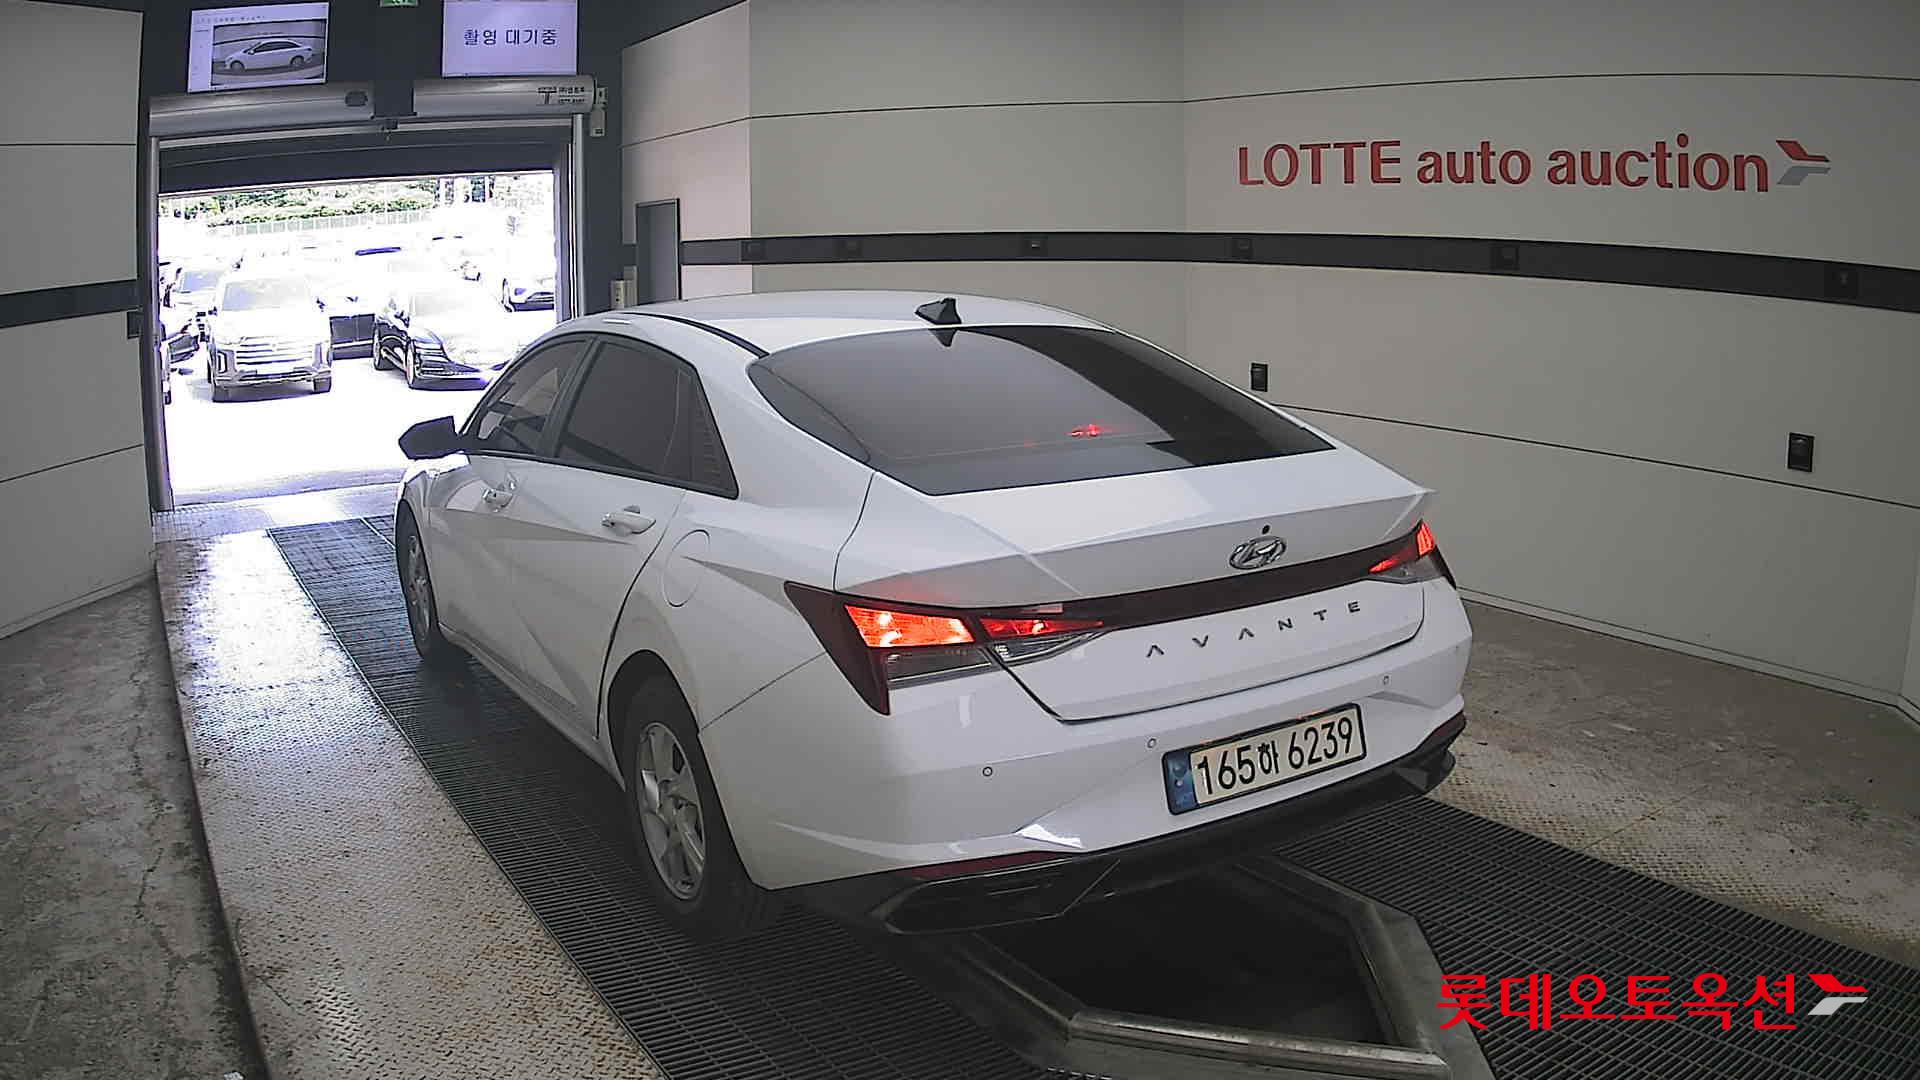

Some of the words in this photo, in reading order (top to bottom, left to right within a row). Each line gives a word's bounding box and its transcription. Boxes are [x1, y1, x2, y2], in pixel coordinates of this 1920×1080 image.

[505, 29, 557, 45] 대기중
[1238, 140, 1401, 187] LOTTE
[1416, 141, 1532, 185] auto
[1546, 133, 1769, 192] auction
[1146, 601, 1360, 658] AVANTE
[1288, 717, 1353, 770] 6239
